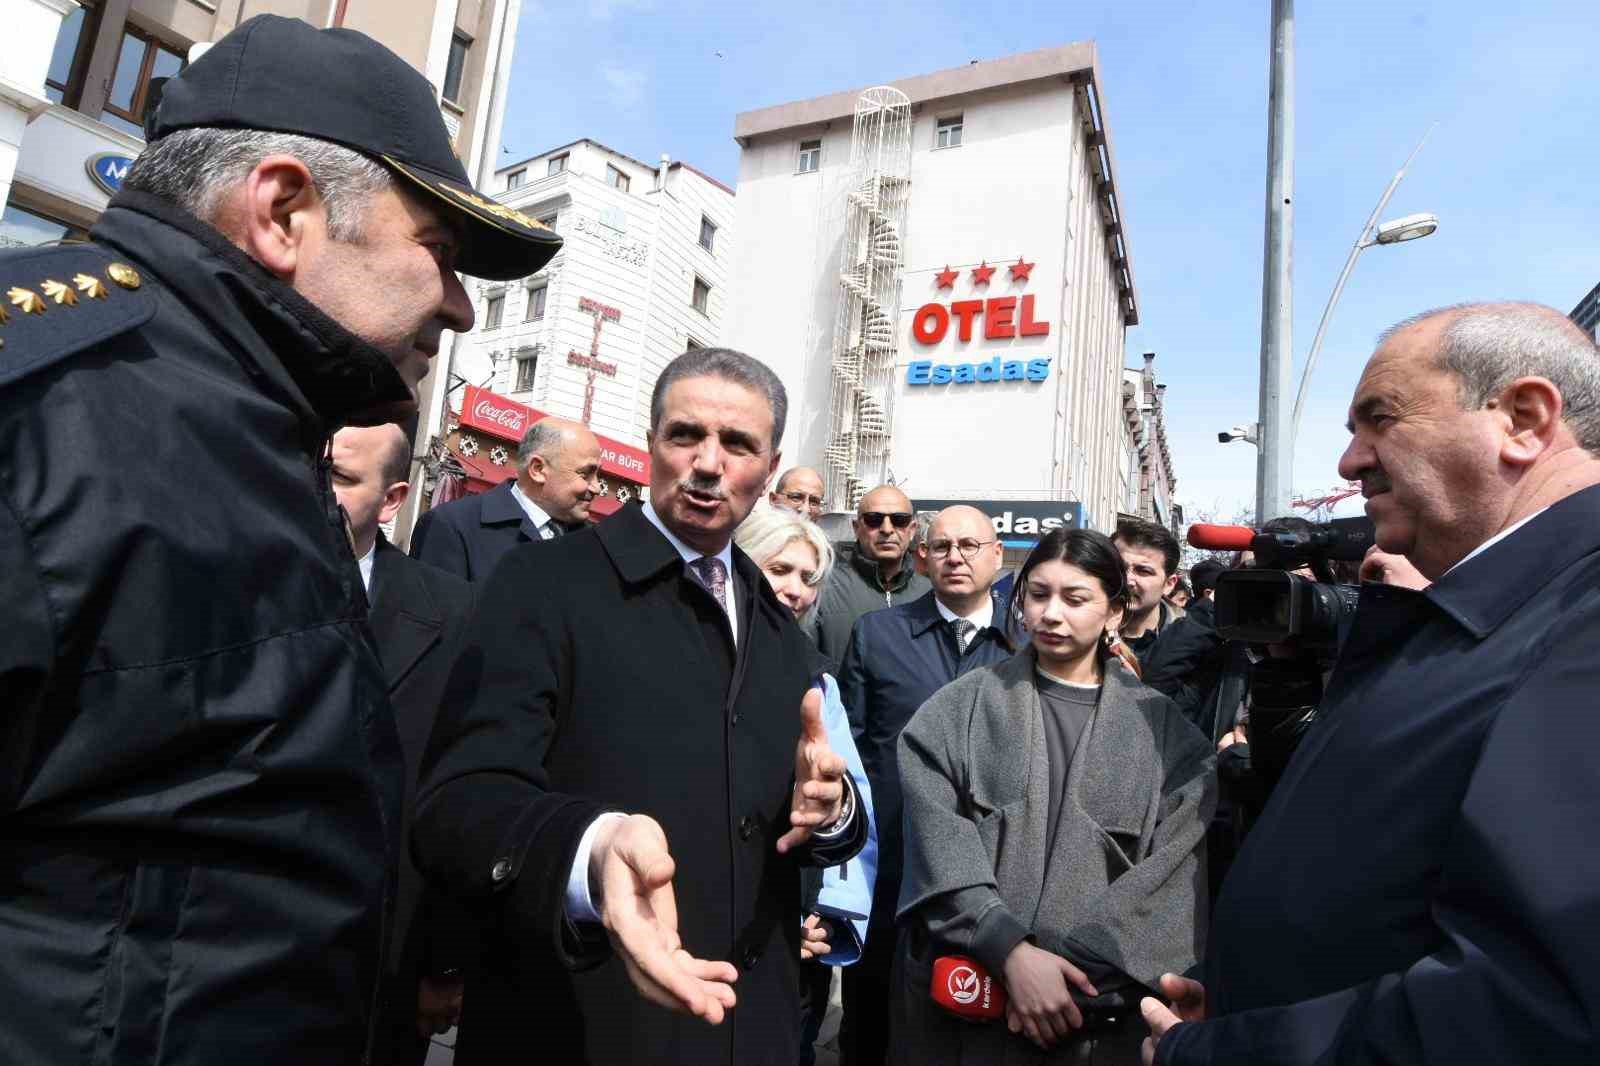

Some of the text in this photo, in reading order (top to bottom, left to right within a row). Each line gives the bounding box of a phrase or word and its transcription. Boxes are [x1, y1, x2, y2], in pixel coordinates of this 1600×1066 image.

[912, 294, 1050, 346] OTEL
[906, 356, 1050, 385] Esadas
[600, 448, 645, 473] AR BÜFE
